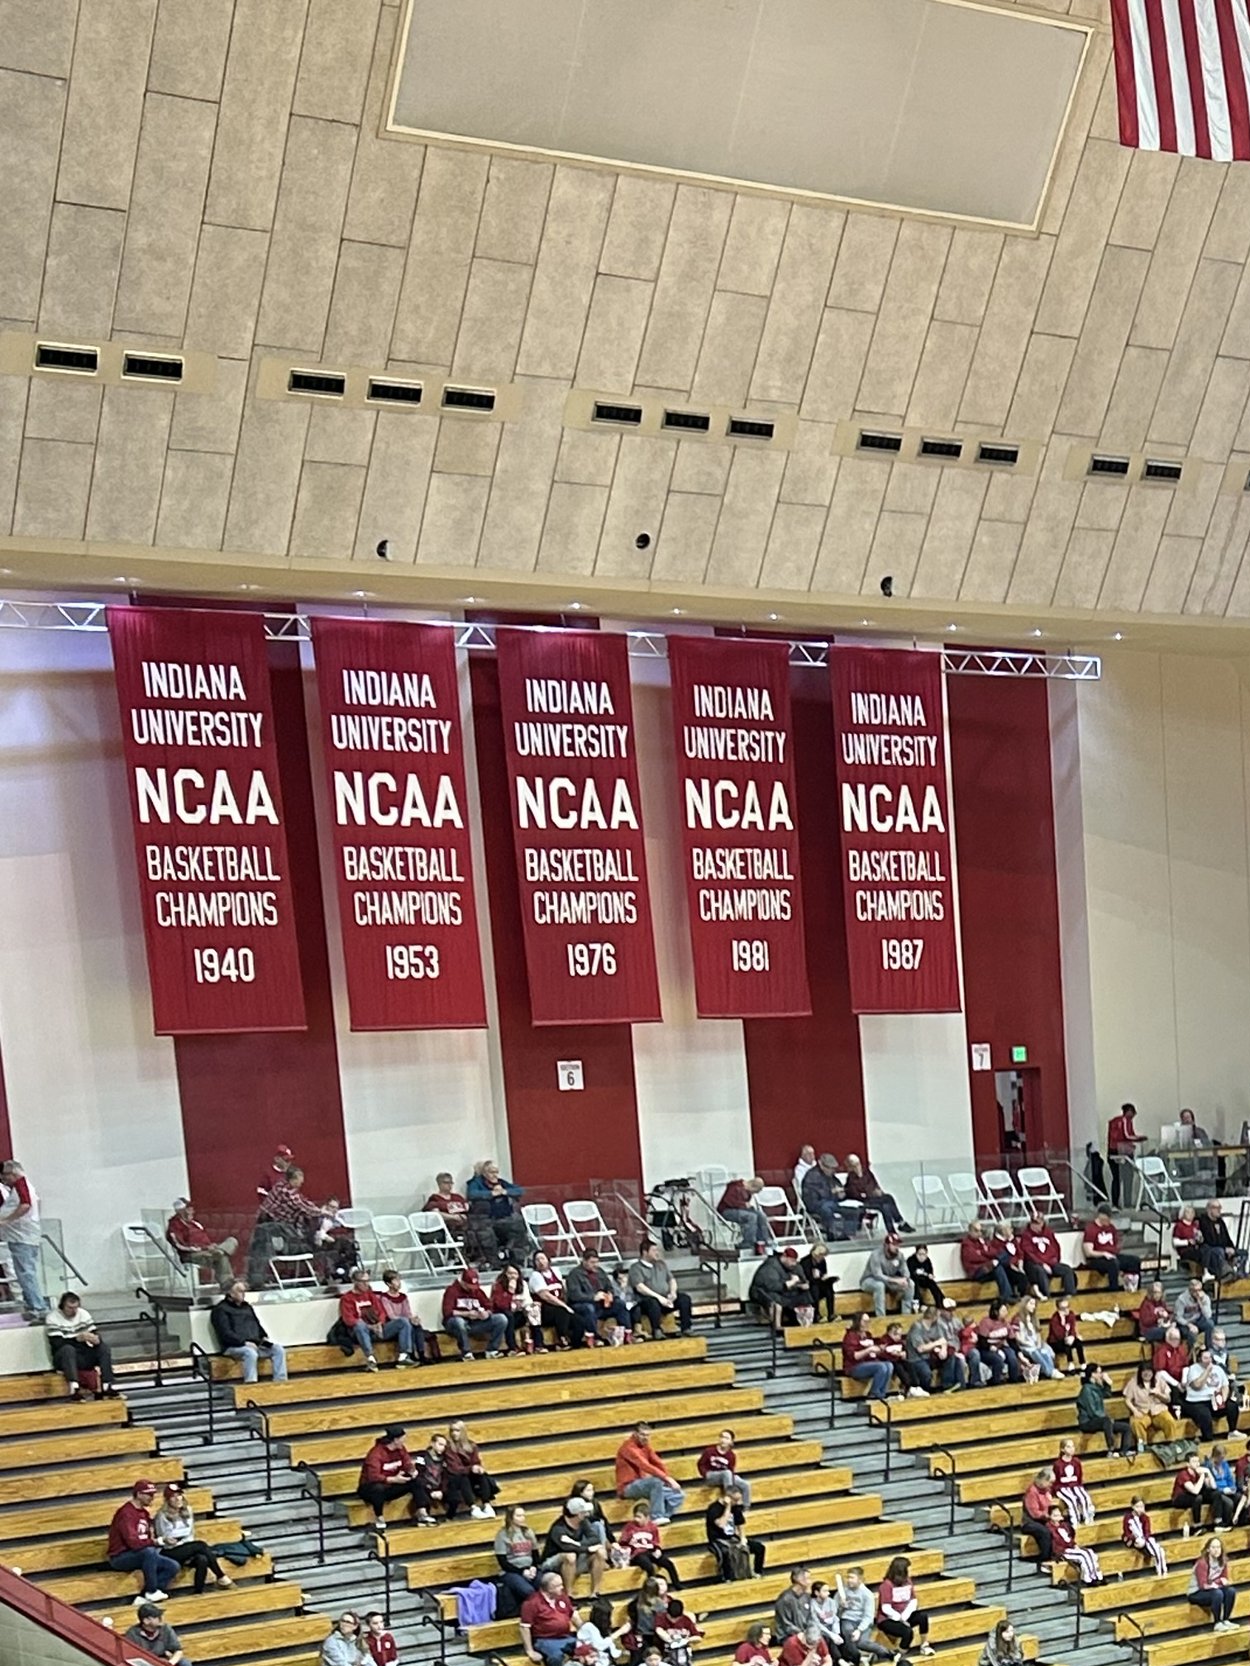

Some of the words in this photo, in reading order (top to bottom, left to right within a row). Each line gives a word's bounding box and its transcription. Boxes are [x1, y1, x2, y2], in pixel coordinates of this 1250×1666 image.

[142, 661, 246, 700] INDIANA
[342, 669, 436, 709] INDIANA
[525, 678, 614, 715] INDIANA
[693, 684, 774, 720] INDIANA
[850, 692, 926, 727] INDIANA
[132, 709, 262, 748] UNIVERSITY
[331, 717, 451, 755] UNIVERSITY
[514, 722, 628, 758] UNIVERSITY
[683, 725, 786, 764] UNIVERSITY
[841, 732, 937, 767] UNIVERSITY
[136, 767, 279, 825] NCAA
[334, 769, 464, 828] NCAA
[517, 775, 639, 832] NCAA
[685, 778, 793, 831] NCAA
[842, 783, 945, 834] NCAA
[146, 845, 281, 882] BASKETBALL
[343, 846, 464, 882] BASKETBALL
[524, 848, 639, 882] BASKETBALL
[692, 847, 794, 881] BASKETBALL
[848, 849, 945, 882] BASKETBALL
[156, 891, 278, 927] CHAMPIONS
[354, 890, 462, 926] CHAMPIONS
[533, 890, 637, 925] CHAMPIONS
[699, 888, 791, 922] CHAMPIONS
[855, 889, 944, 922] CHAMPIONS
[194, 947, 255, 984] 1940
[385, 944, 439, 980] 1953
[567, 942, 617, 977] 1976
[731, 939, 769, 972] 1981
[881, 938, 923, 970] 1987
[567, 1071, 575, 1086] 6
